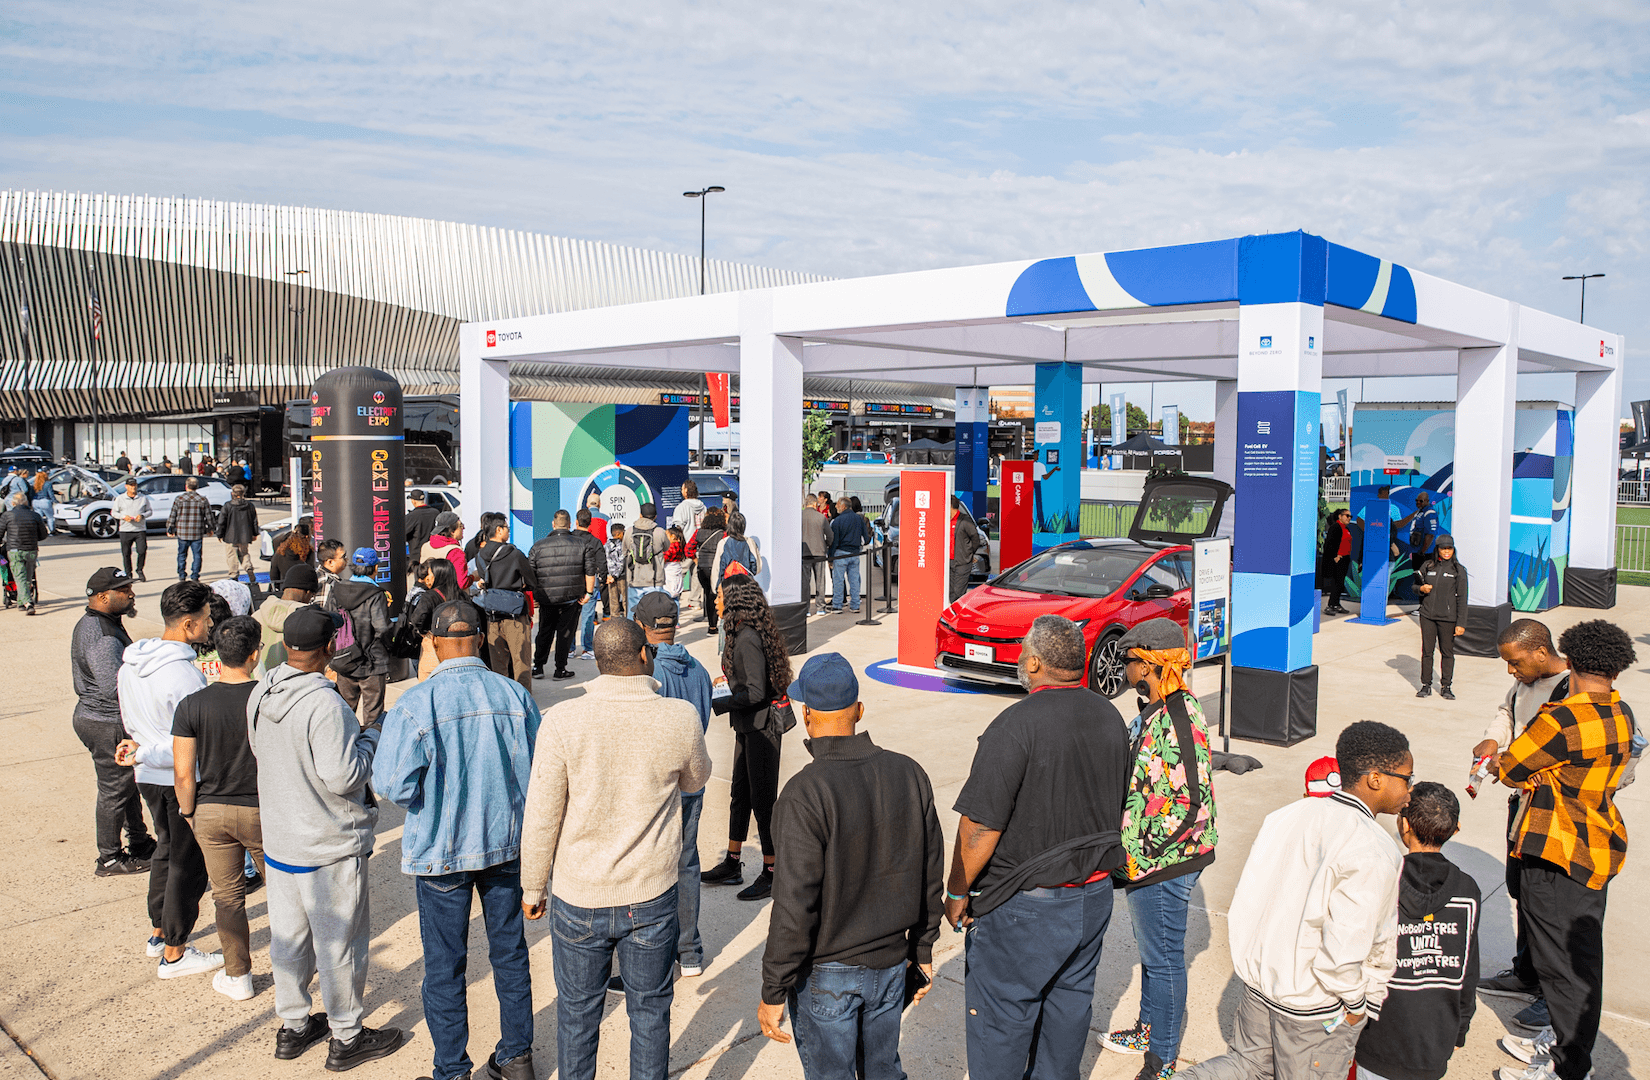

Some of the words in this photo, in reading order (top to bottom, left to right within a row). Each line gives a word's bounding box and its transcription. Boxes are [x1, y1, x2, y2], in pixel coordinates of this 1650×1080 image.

[498, 331, 522, 342] TOYOTA
[670, 394, 696, 404] ELECTRIFY
[357, 406, 397, 417] ELECTRIFY
[368, 416, 390, 426] EXPO
[295, 444, 313, 452] VOL
[312, 449, 323, 493] EXPO
[371, 449, 389, 492] EXPO
[609, 496, 626, 504] SPIN
[1014, 484, 1022, 506] CAMRY
[613, 504, 623, 512] TO
[917, 511, 926, 538] PRIUS
[917, 540, 926, 568] PRIME
[1199, 568, 1209, 576] DRIVE
[1199, 576, 1213, 584] TOYOTA
[1214, 574, 1225, 582] TODAY
[1433, 921, 1458, 935] FREE
[1434, 955, 1460, 968] FREE
